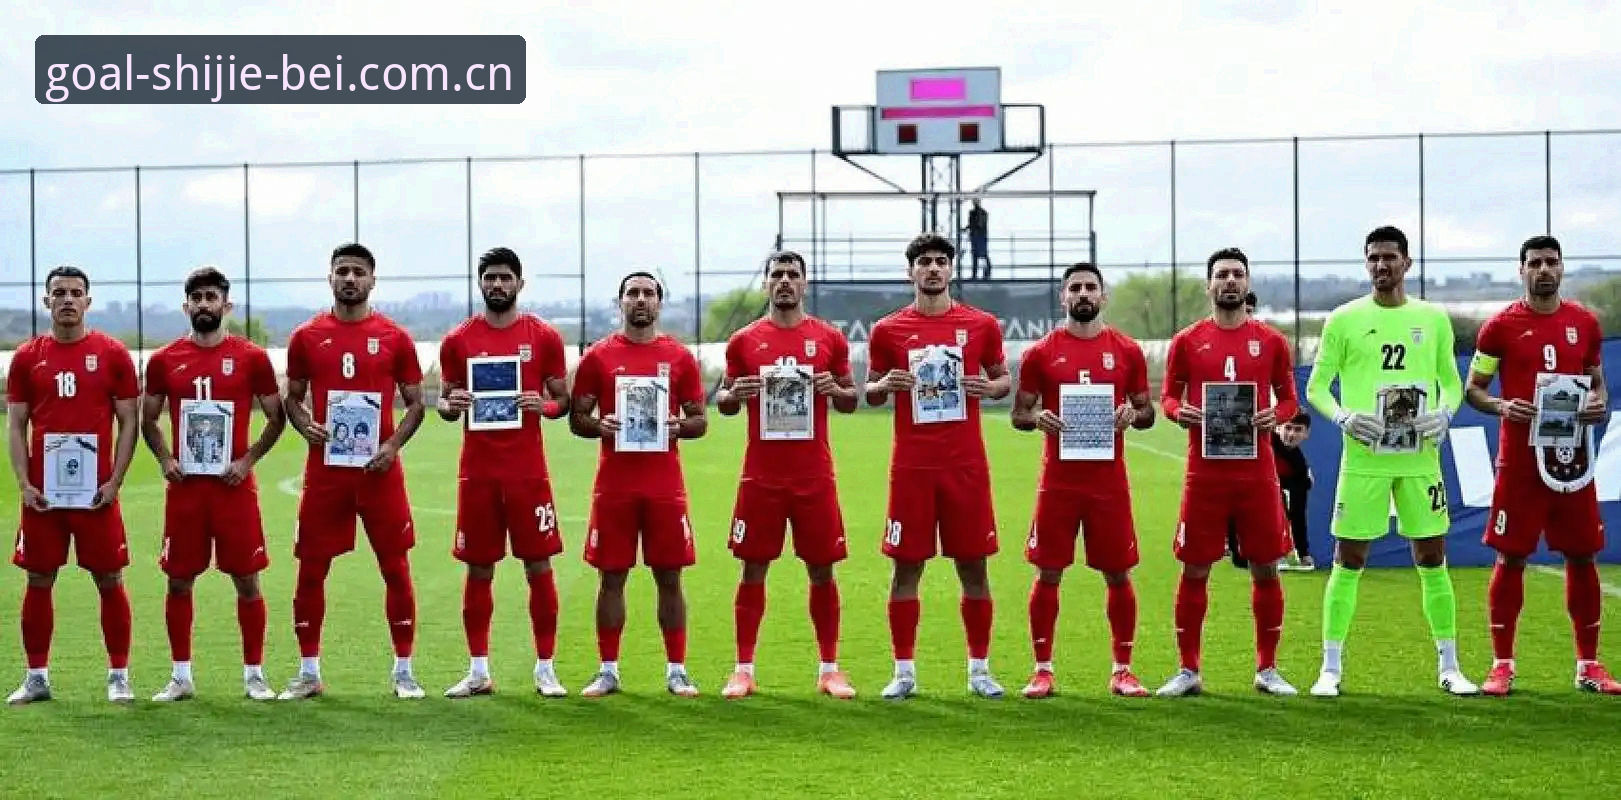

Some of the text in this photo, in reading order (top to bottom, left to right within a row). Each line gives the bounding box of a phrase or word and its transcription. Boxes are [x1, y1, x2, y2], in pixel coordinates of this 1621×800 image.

[342, 352, 355, 379] 8
[1224, 355, 1237, 381] 4
[1381, 344, 1405, 370] 22
[1543, 344, 1557, 370] 9
[54, 371, 76, 397] 18
[192, 376, 212, 400] 11
[1078, 369, 1092, 384] 5
[733, 518, 746, 544] 9
[1495, 510, 1507, 536] 9
